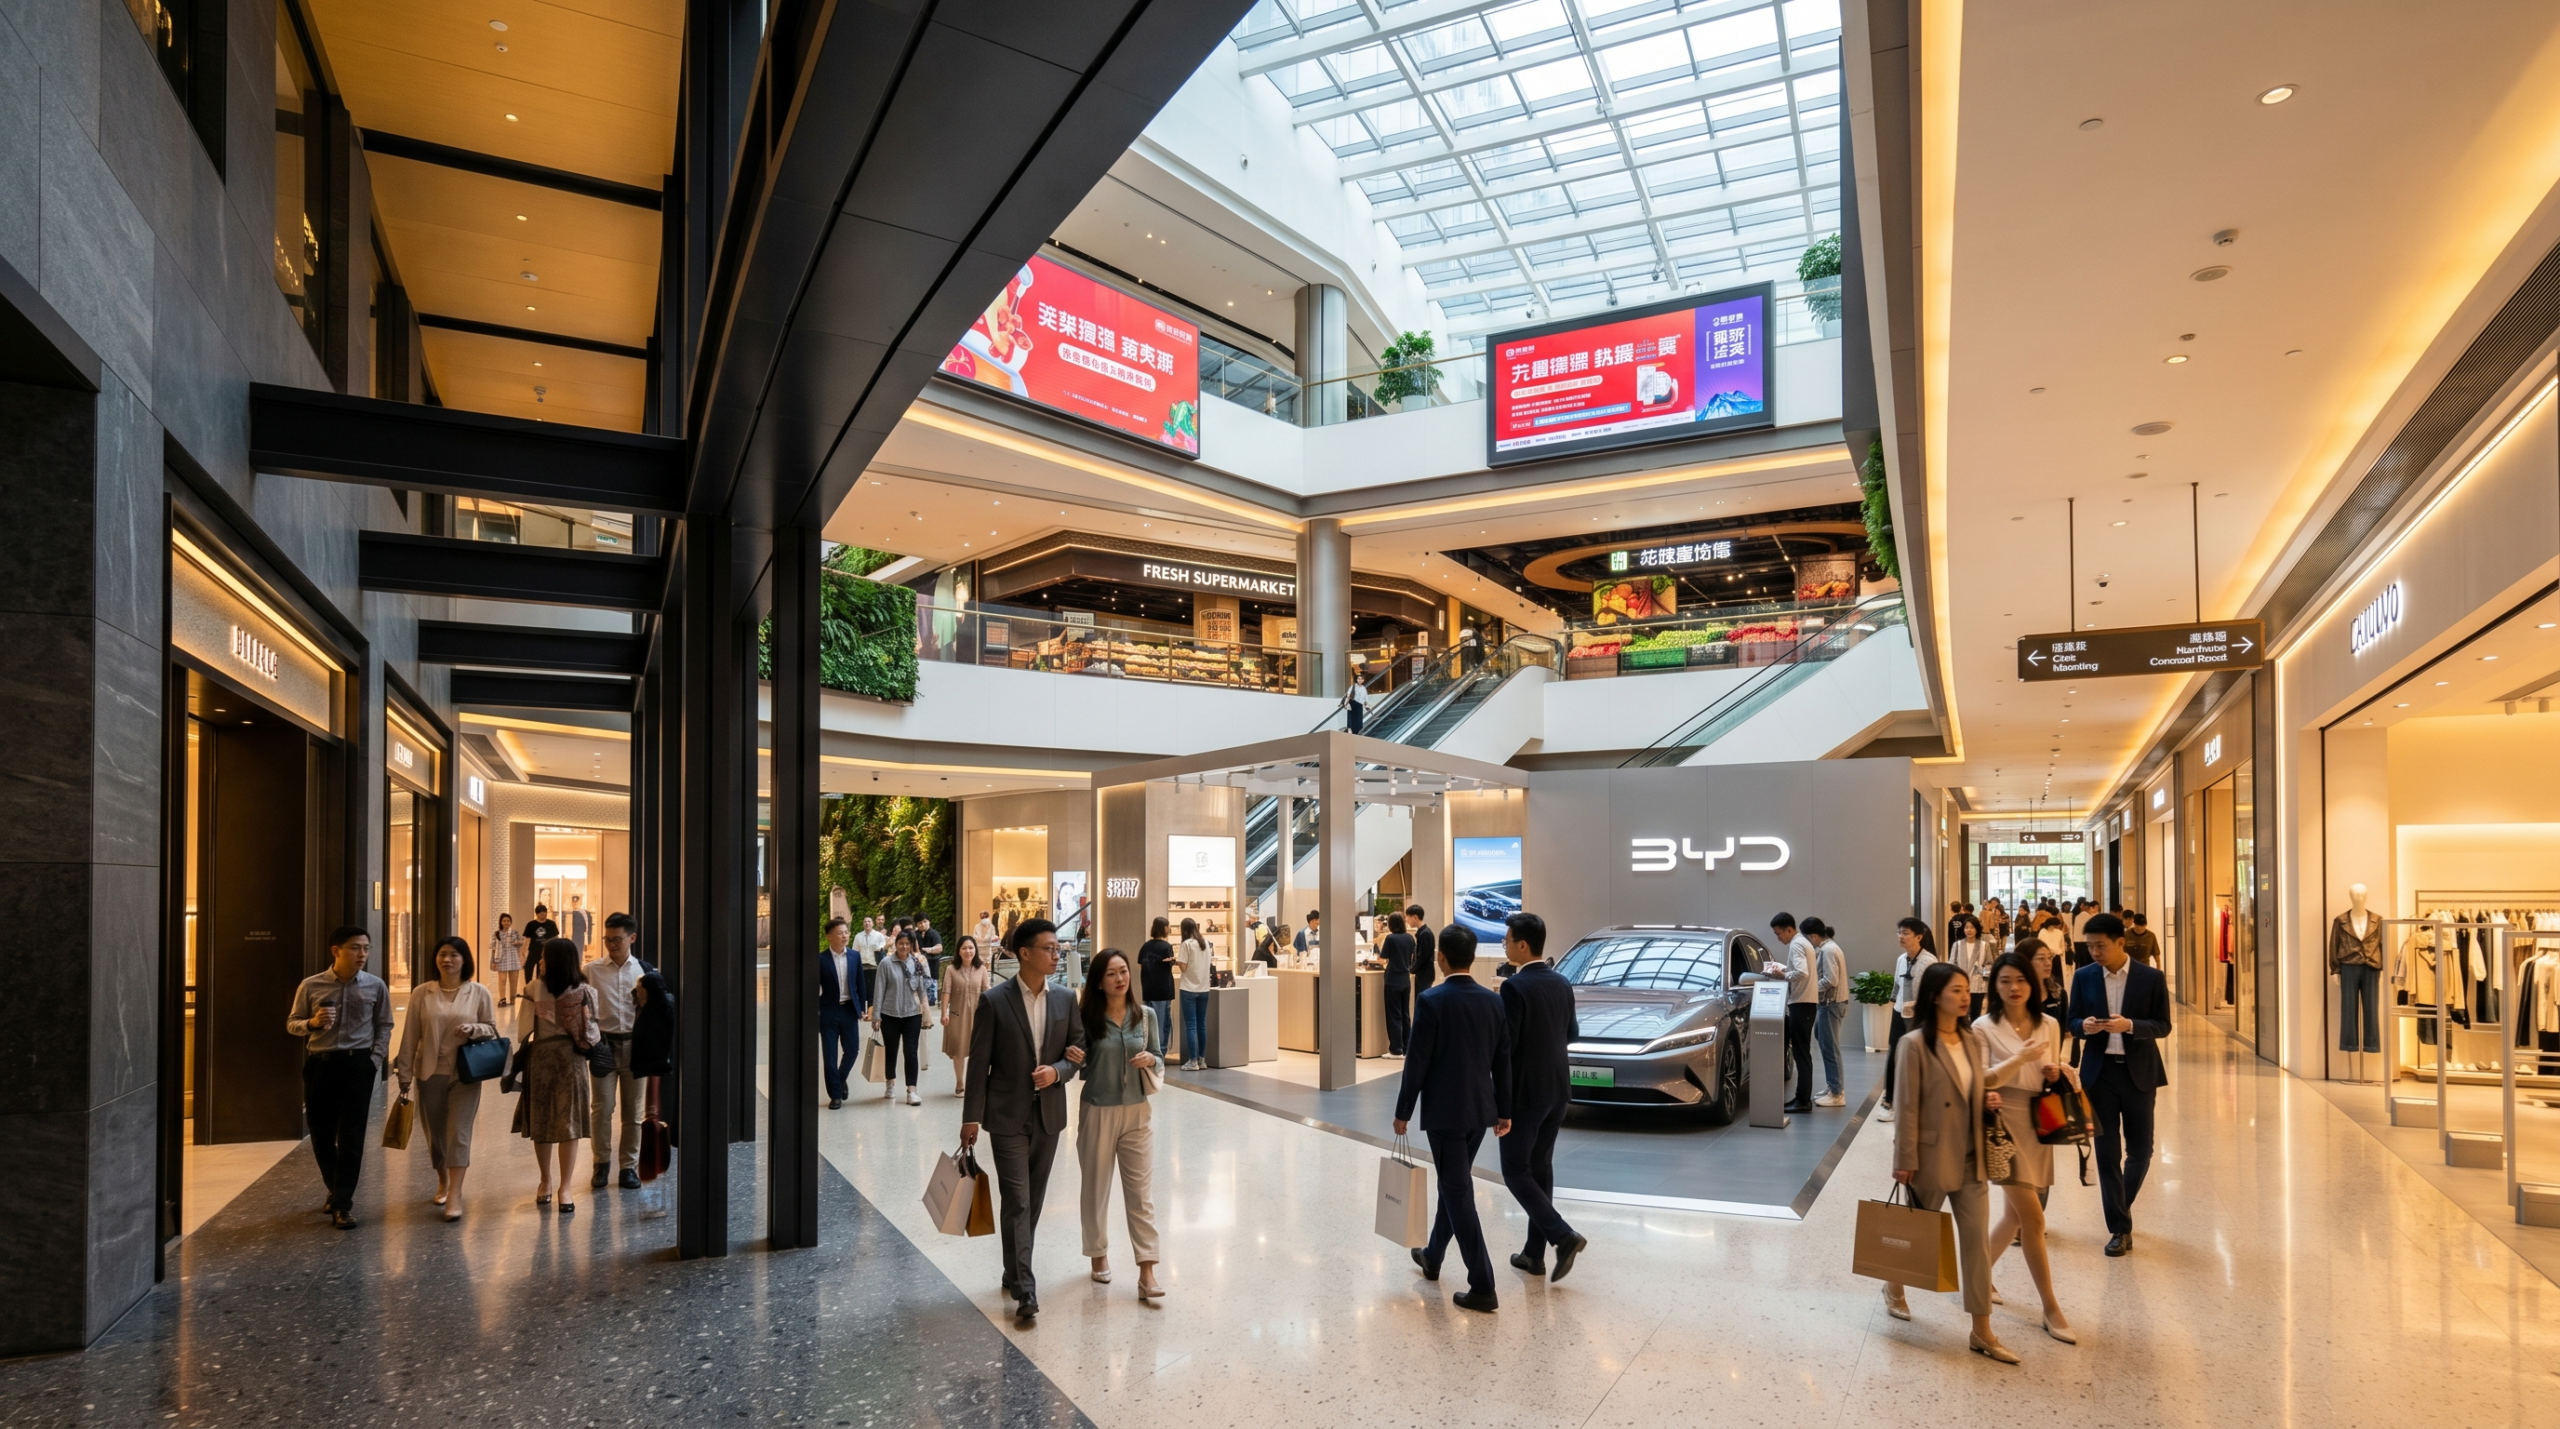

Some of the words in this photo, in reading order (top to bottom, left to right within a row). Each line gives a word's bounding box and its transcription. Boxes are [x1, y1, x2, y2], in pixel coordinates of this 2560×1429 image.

[1143, 564, 1189, 583] FRESH
[1193, 571, 1296, 596] SUPERMARKET
[1632, 836, 1790, 872] BYD
